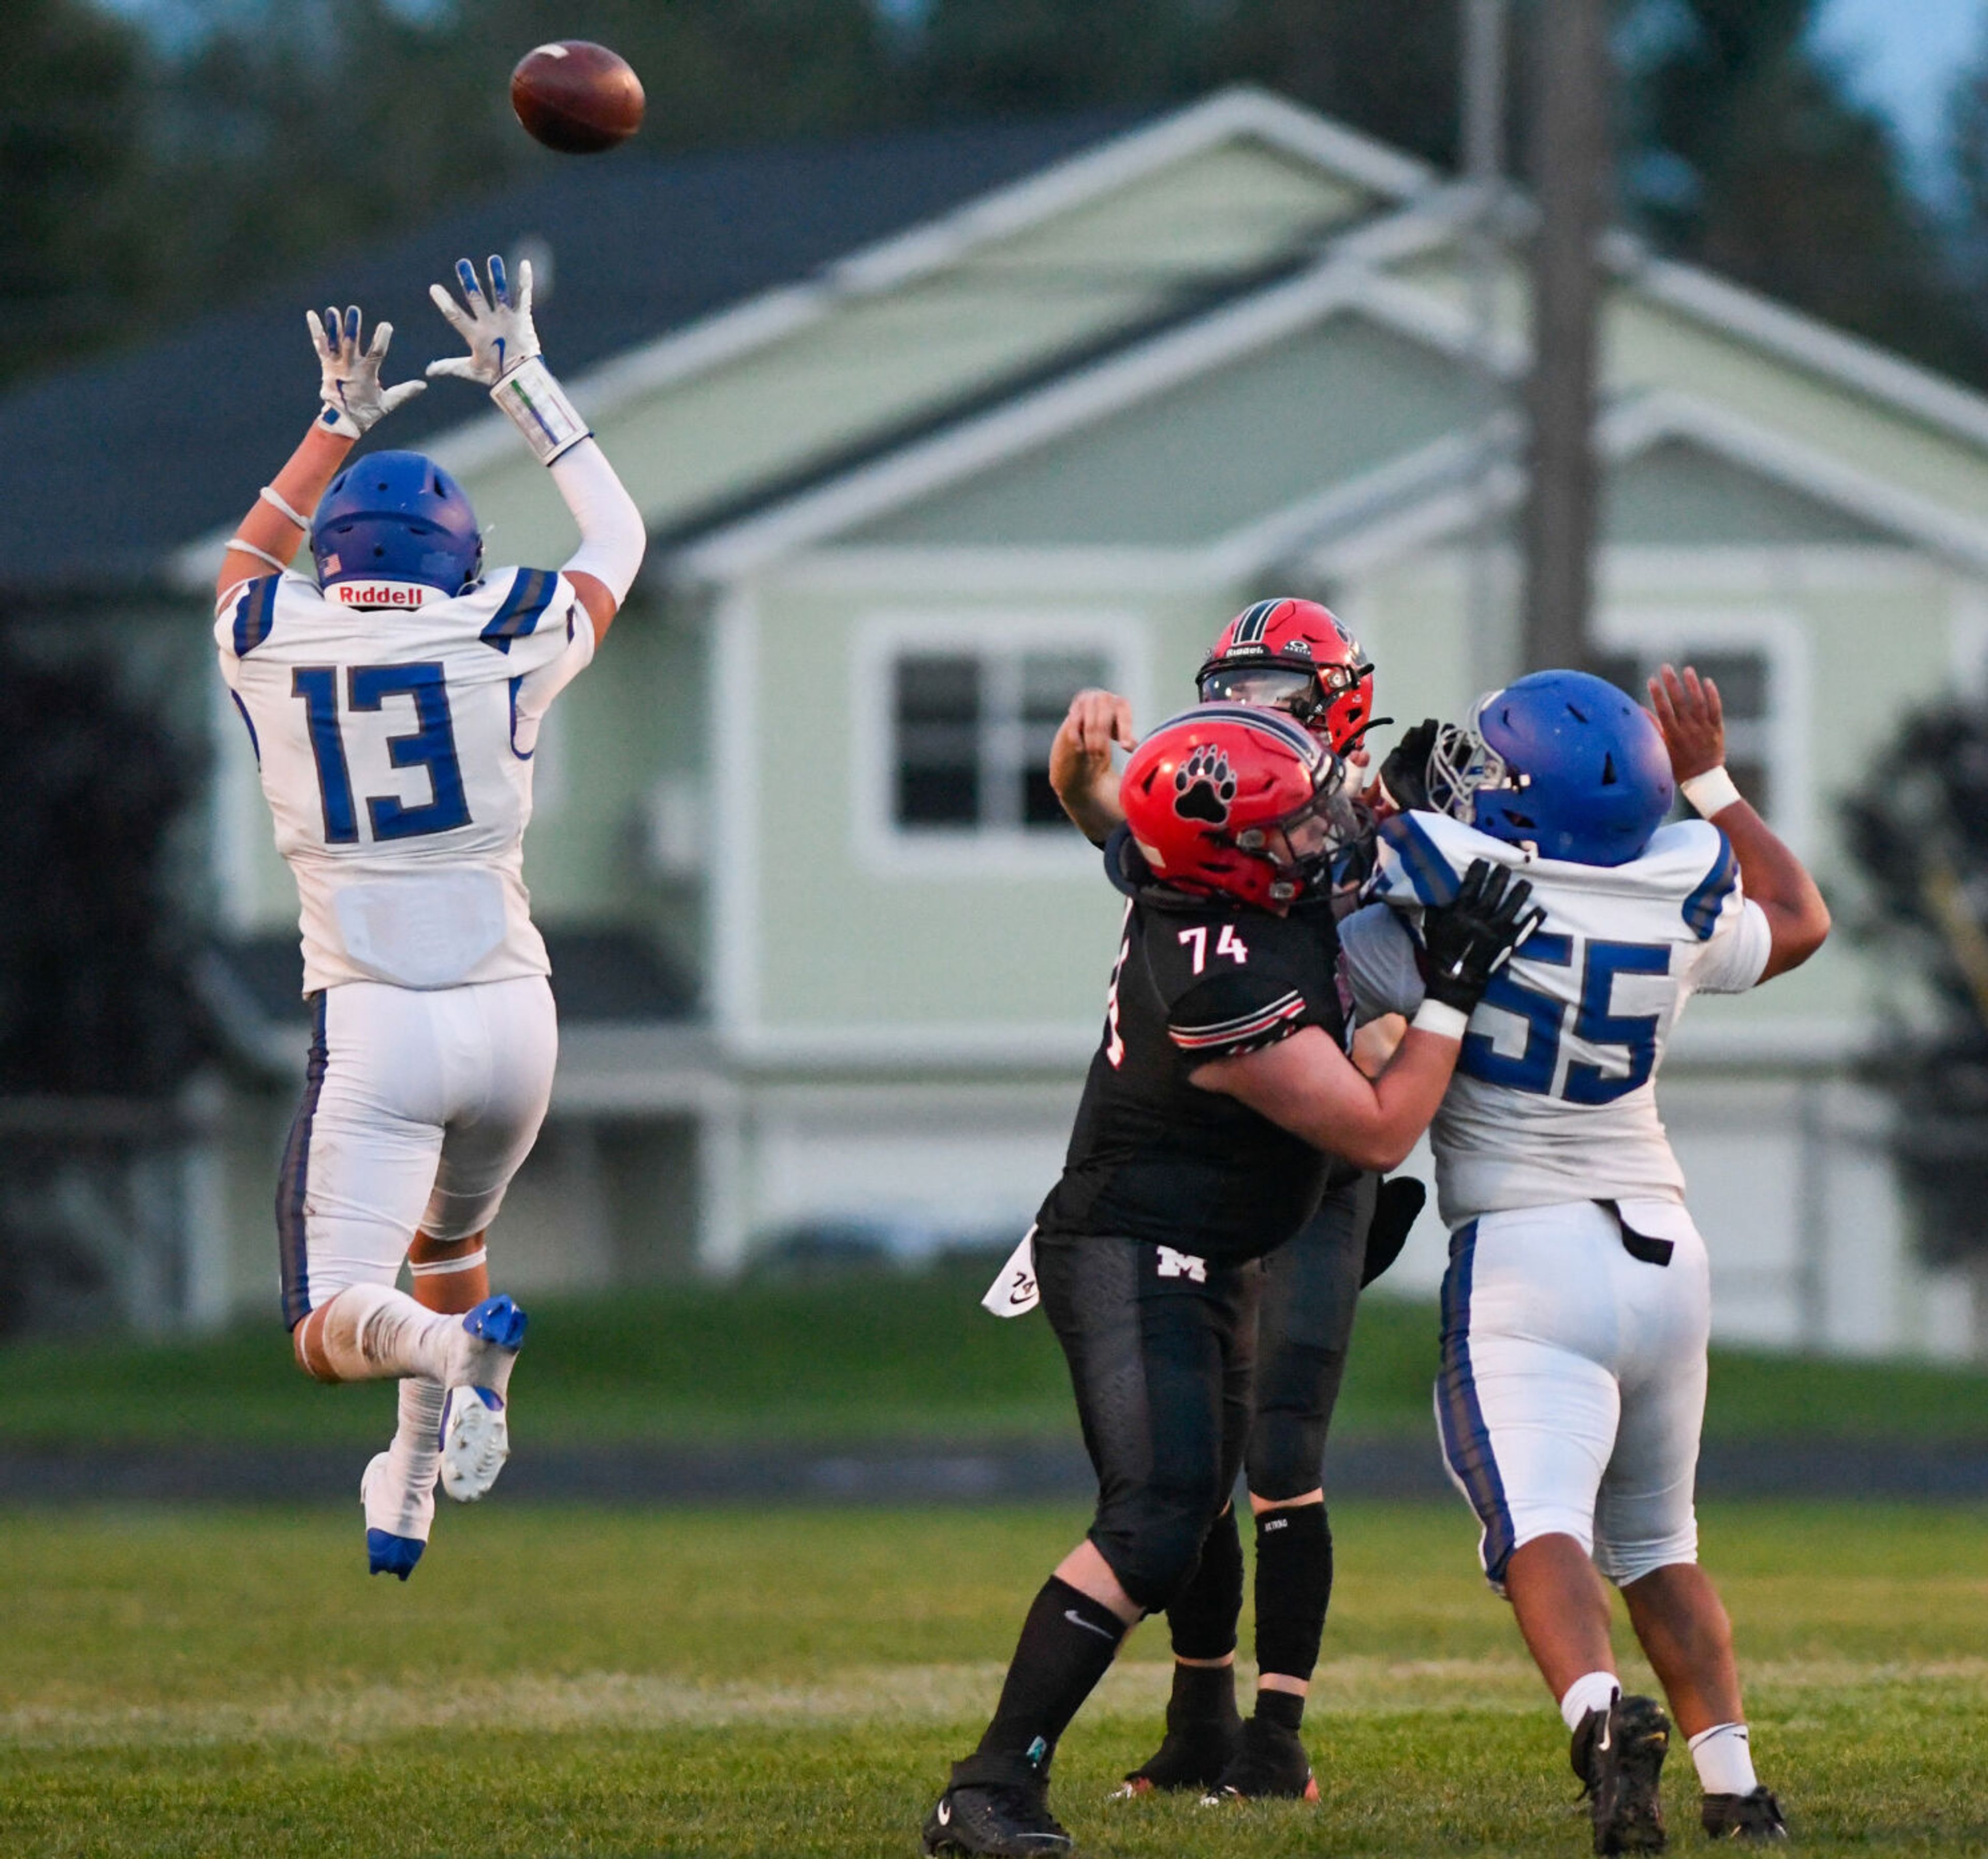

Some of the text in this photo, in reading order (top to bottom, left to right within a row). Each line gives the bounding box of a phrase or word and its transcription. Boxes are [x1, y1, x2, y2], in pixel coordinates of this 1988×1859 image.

[340, 586, 422, 605] Riddell
[291, 661, 473, 844] 13
[1177, 924, 1248, 976] 74
[1455, 931, 1672, 1105] 55
[1157, 1244, 1207, 1283] M
